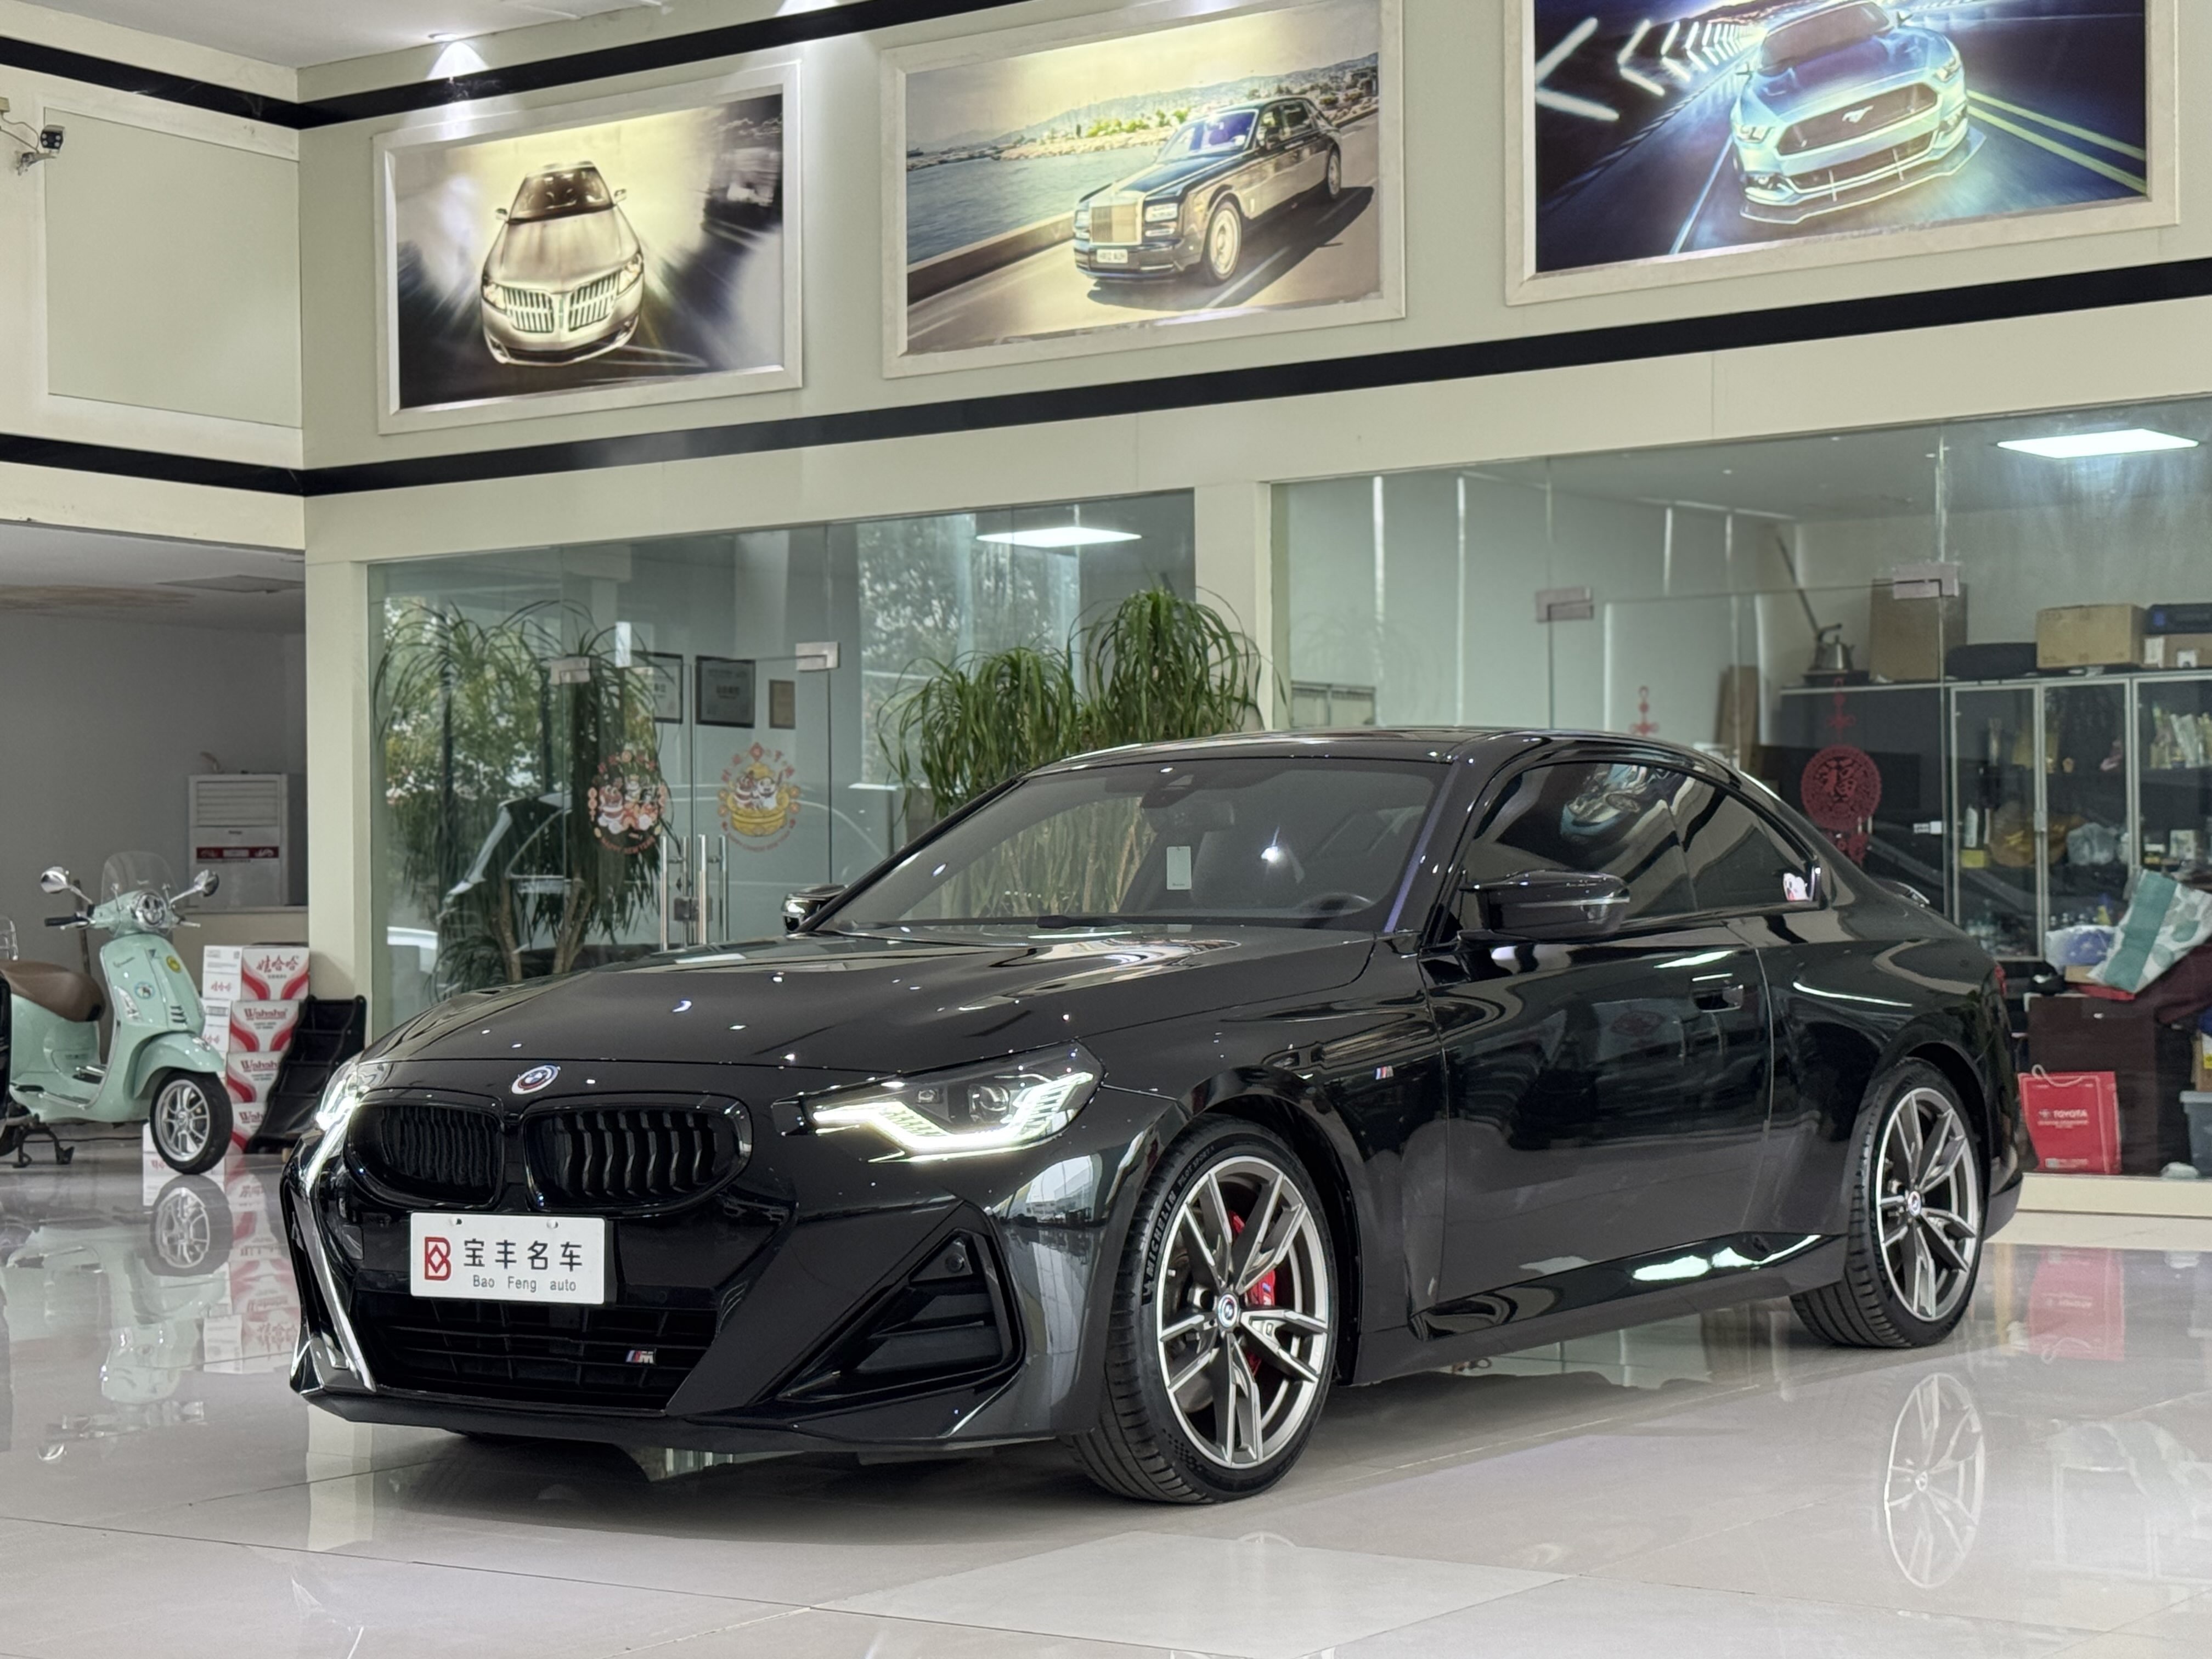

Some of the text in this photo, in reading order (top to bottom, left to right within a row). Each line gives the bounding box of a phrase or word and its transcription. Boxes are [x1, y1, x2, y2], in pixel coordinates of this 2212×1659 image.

[1815, 759, 1857, 797] 福
[240, 1059, 278, 1072] Wahah
[2053, 1109, 2087, 1118] TOYOTA
[1146, 1189, 1177, 1277] MICHELIN
[464, 1238, 583, 1272] 宝丰名车
[473, 1274, 577, 1293] Bao Feng auto
